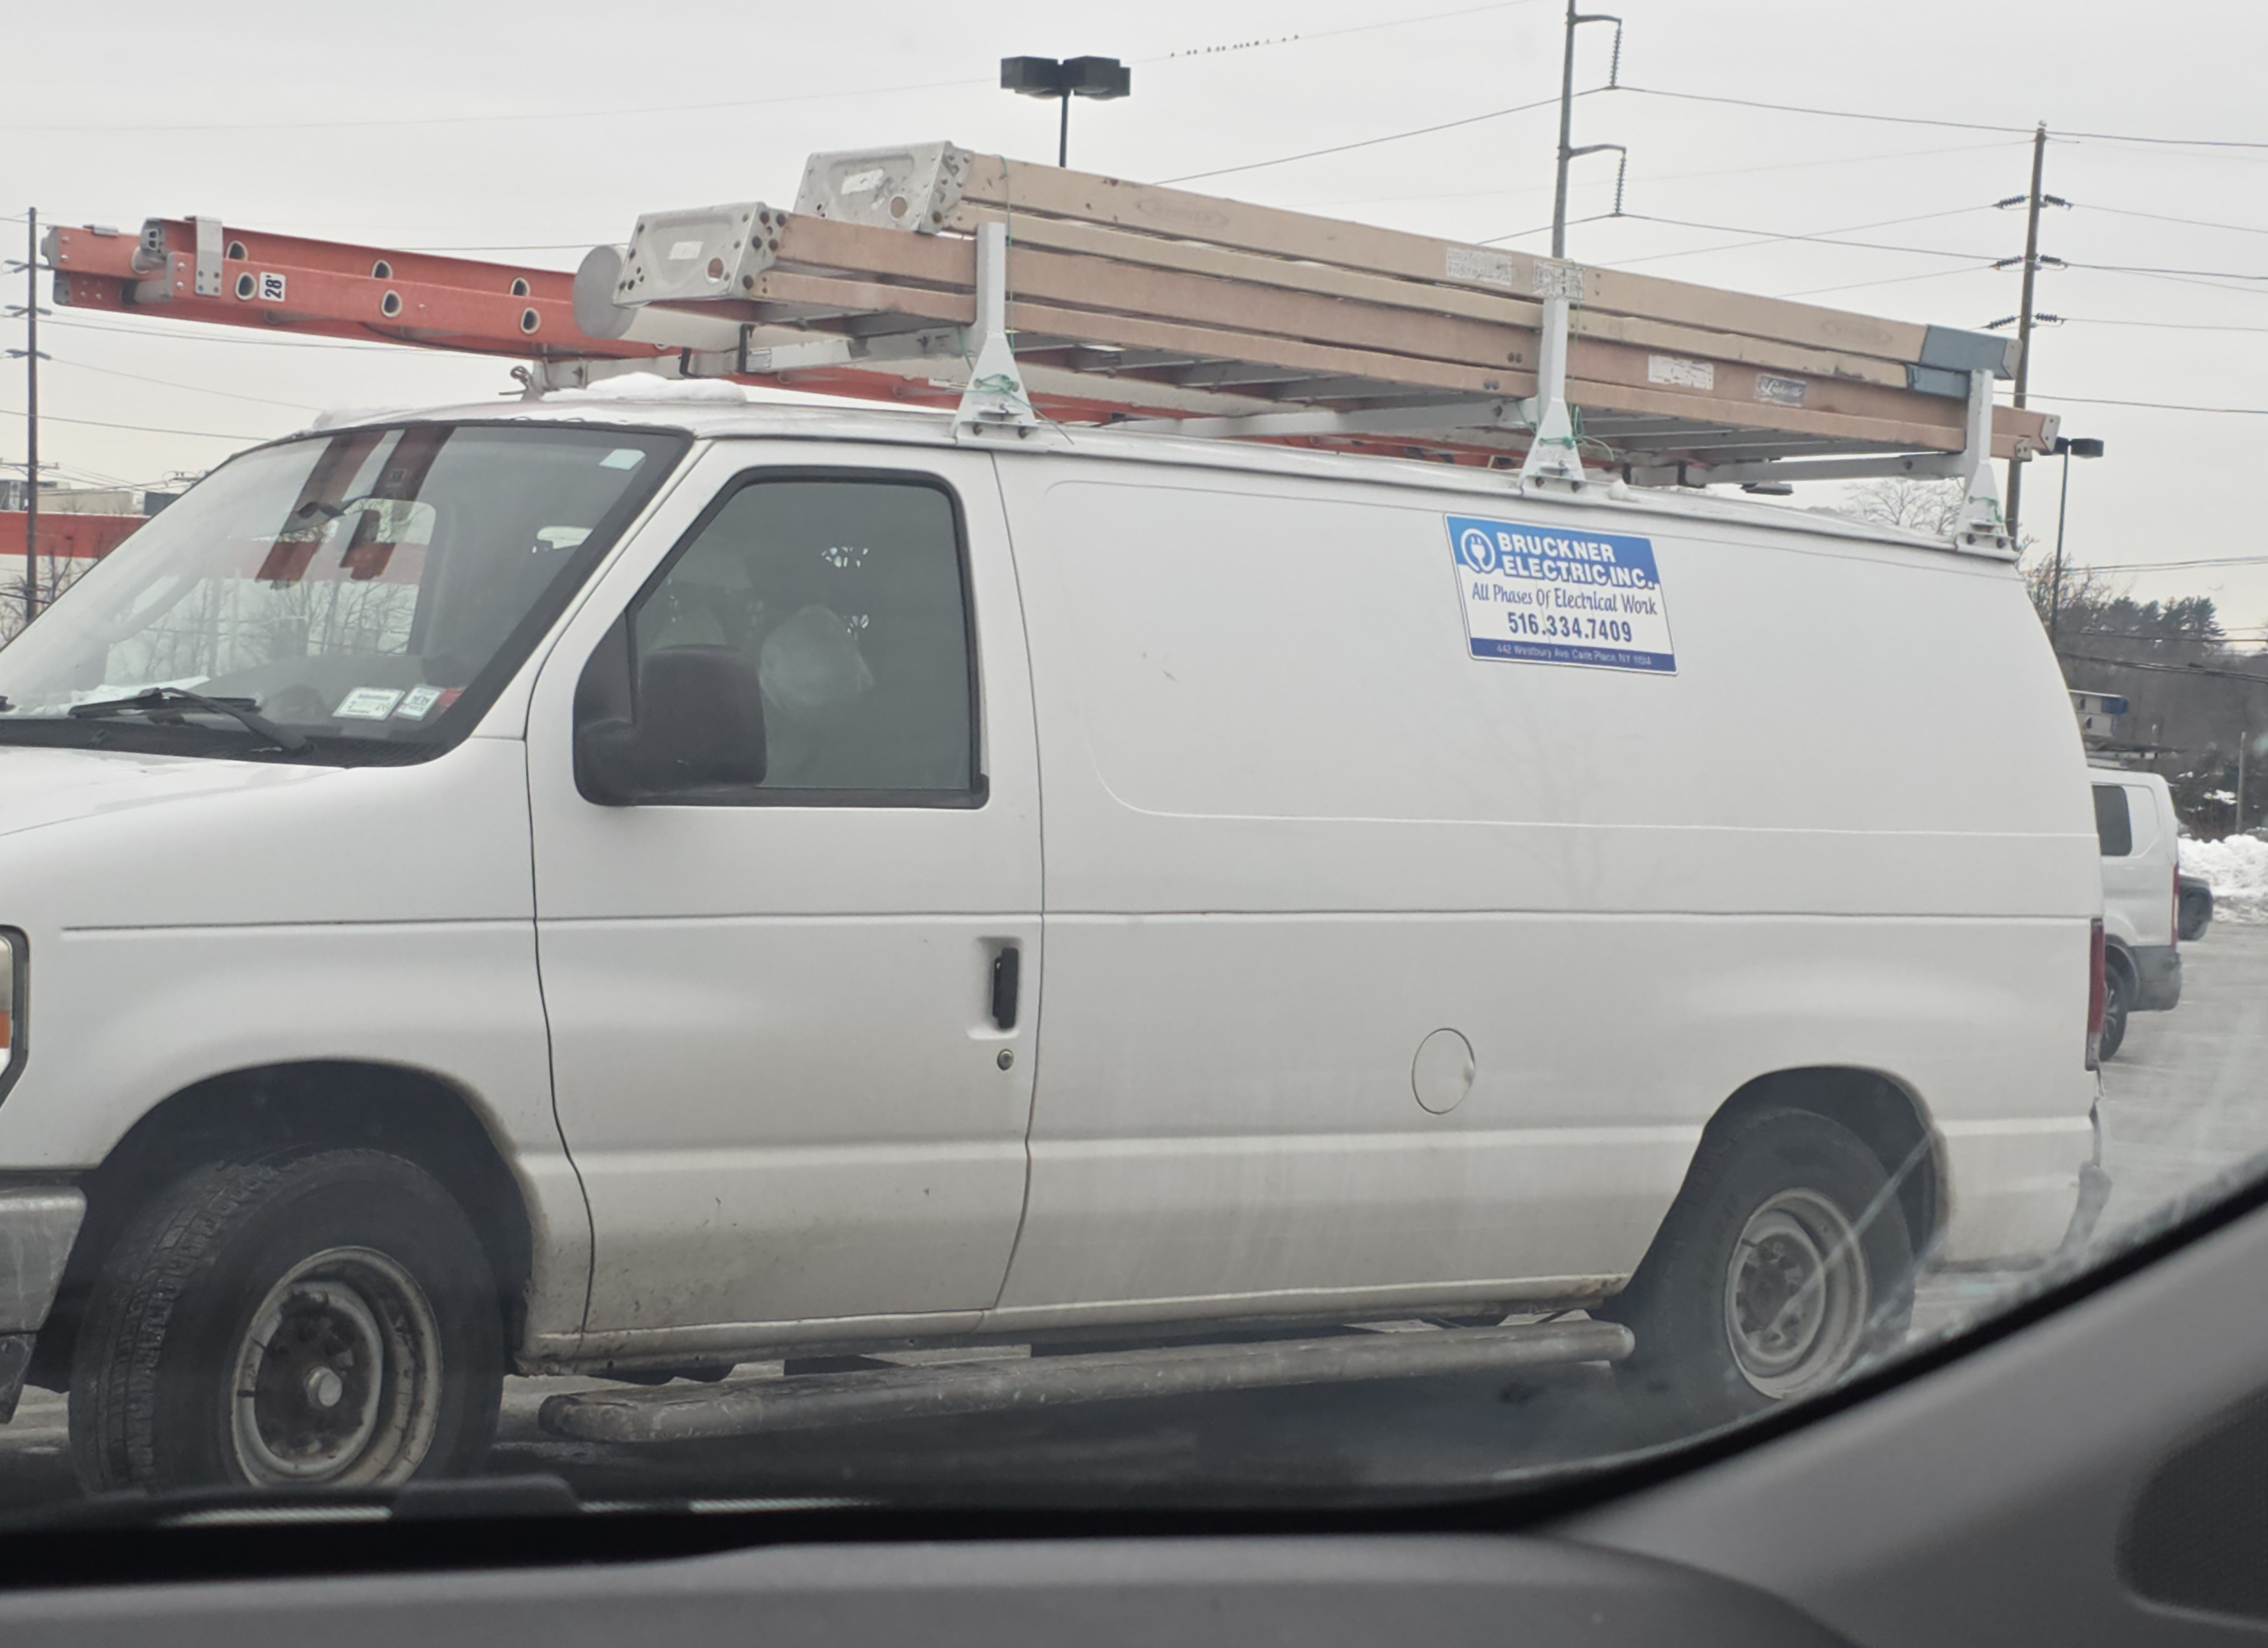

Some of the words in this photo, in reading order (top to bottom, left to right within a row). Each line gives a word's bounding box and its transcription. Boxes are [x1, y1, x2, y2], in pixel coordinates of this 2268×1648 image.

[1497, 532, 1616, 563] BRUCKNER
[1502, 555, 1609, 585] ELECTRIC
[1609, 566, 1654, 589] INC.
[1472, 582, 1490, 601] All
[1493, 584, 1533, 605] Phases
[1536, 588, 1552, 610] Of
[1554, 588, 1618, 612] Electrical
[1621, 592, 1657, 615] Work
[1507, 612, 1632, 642] 516.334.7409
